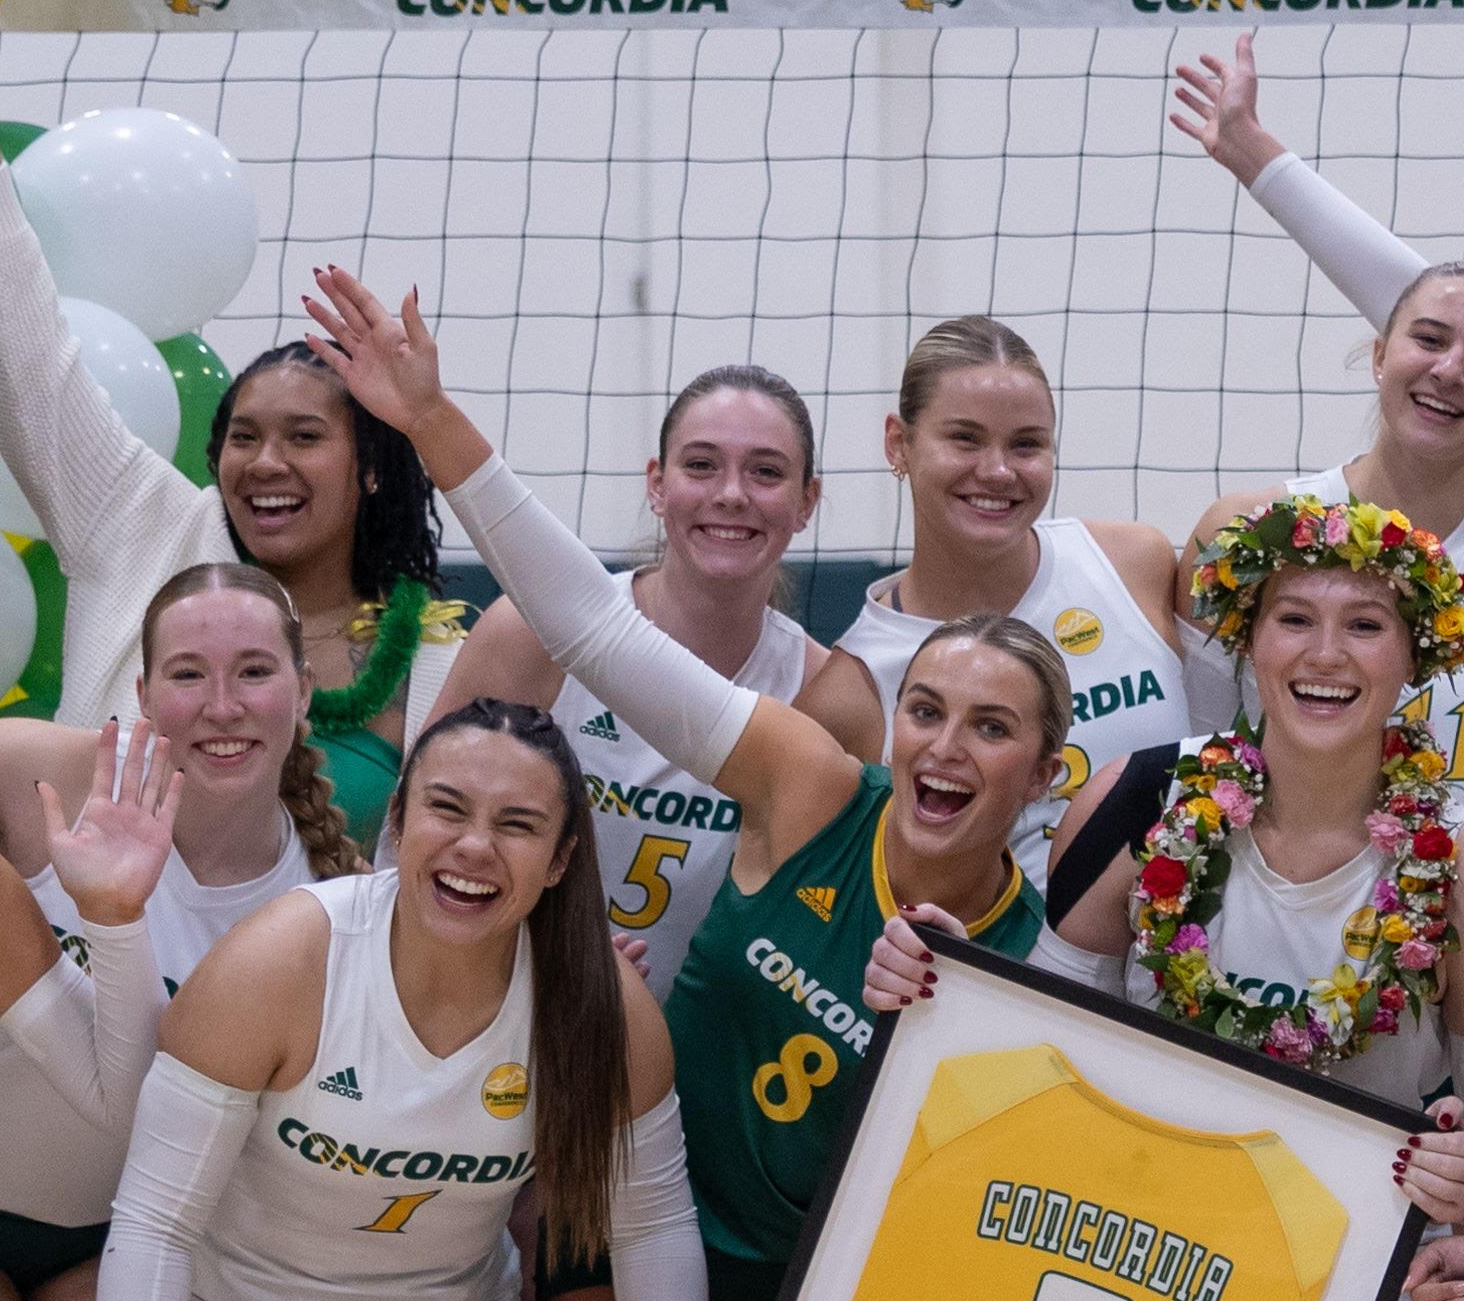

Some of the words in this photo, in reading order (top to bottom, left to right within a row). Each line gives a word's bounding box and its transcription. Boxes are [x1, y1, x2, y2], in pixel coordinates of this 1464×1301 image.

[580, 725, 620, 742] adidas
[608, 835, 692, 929] 5
[745, 937, 873, 1056] CONCOR
[318, 1081, 363, 1101] adidas
[752, 1032, 838, 1122] 8
[354, 1189, 443, 1235] 1
